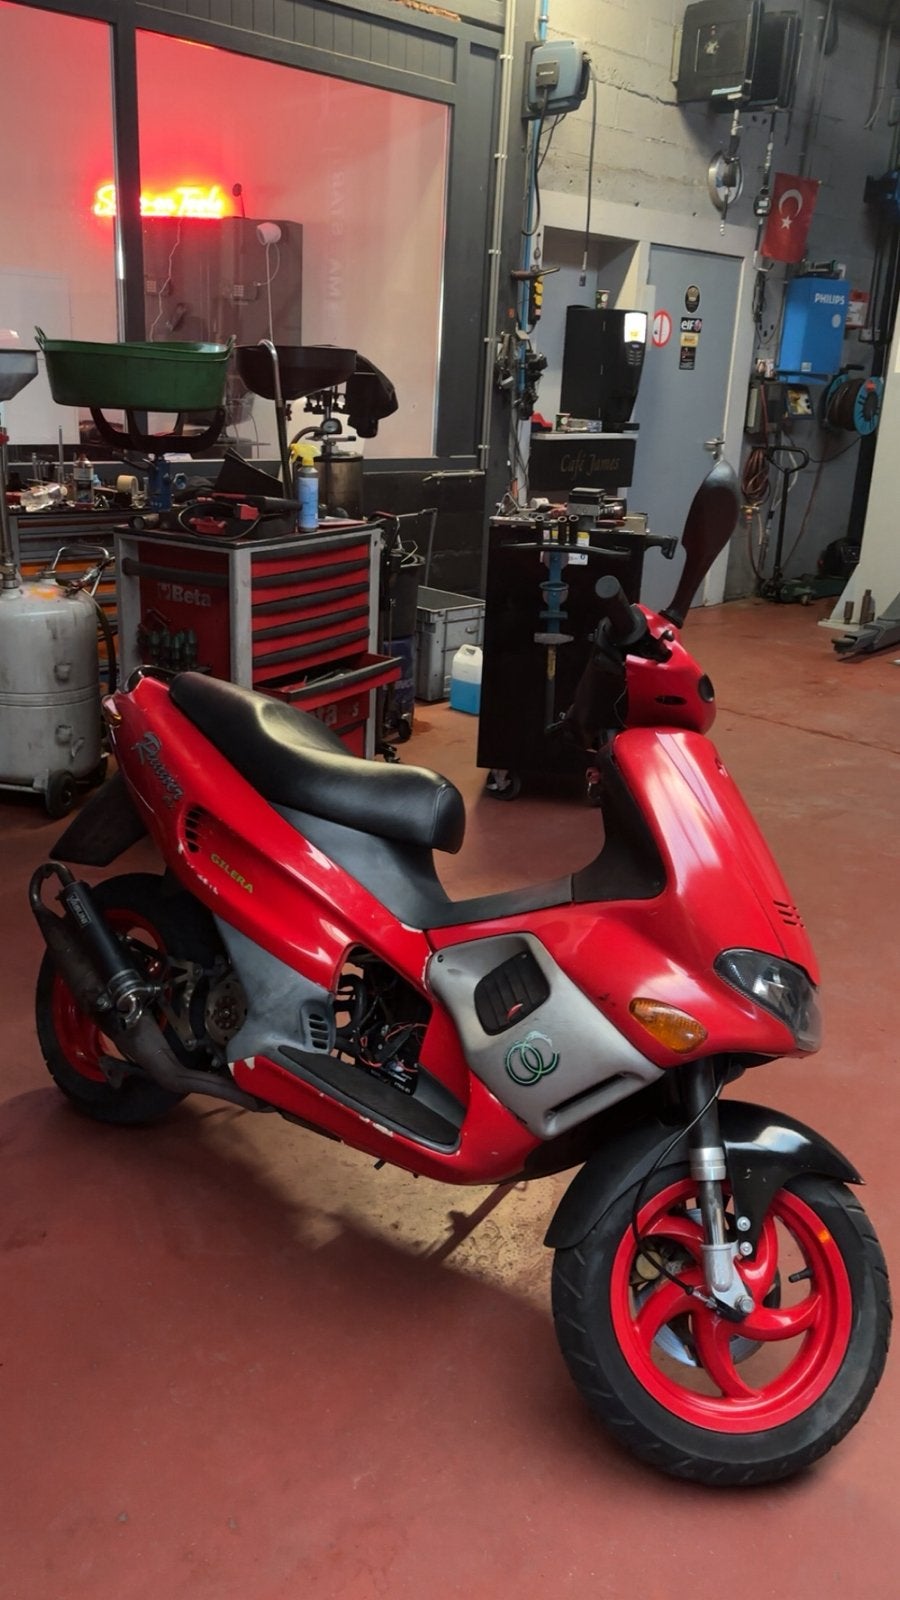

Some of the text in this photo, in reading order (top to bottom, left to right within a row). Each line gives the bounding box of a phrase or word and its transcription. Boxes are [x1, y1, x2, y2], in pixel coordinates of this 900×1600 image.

[814, 292, 846, 305] PHILIPS
[681, 320, 695, 330] elf
[560, 449, 621, 481] Café James
[171, 584, 212, 608] Beta
[210, 852, 254, 894] GILERA
